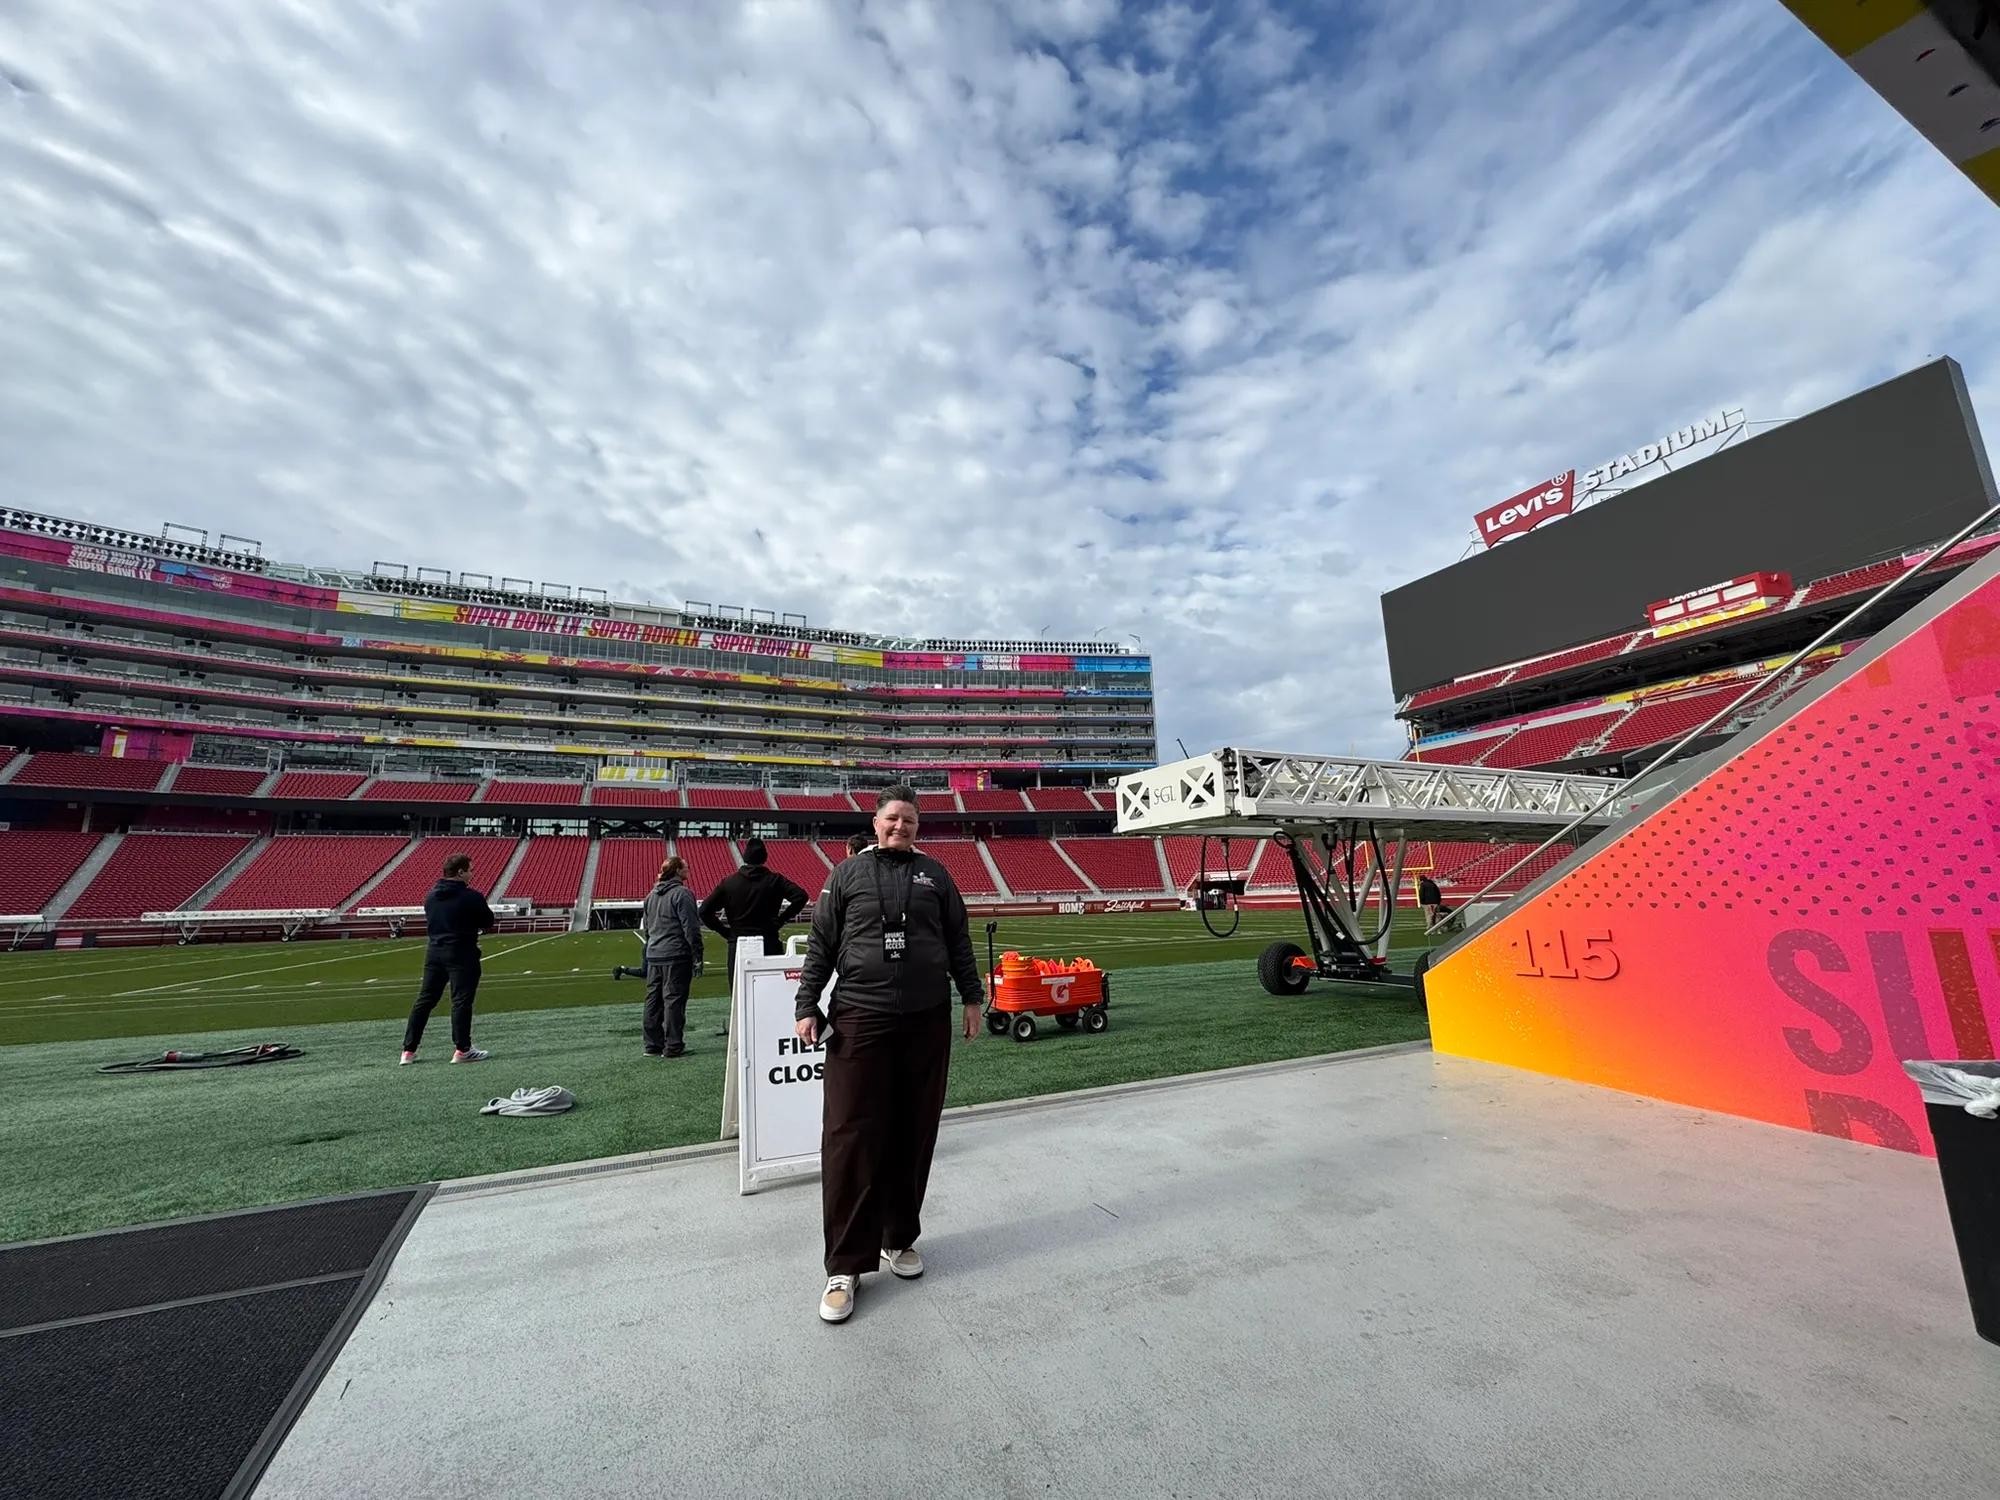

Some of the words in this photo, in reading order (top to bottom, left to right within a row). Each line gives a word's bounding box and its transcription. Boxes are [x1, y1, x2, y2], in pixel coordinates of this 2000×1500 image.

[1583, 411, 1729, 490] STADIUM
[453, 605, 511, 629] SUPER
[512, 610, 559, 632] BOWL
[560, 615, 582, 636] LX
[588, 619, 640, 641] SUPER
[640, 625, 680, 645] BOWL
[683, 630, 701, 648] LX
[711, 633, 756, 653] SUPER
[757, 639, 792, 657] BOWL
[795, 642, 812, 659] LX
[1153, 786, 1176, 805] SGL
[1058, 902, 1084, 914] HOME
[885, 942, 906, 950] ACCESS
[1511, 928, 1620, 981] 115
[1767, 928, 2000, 1076] SU
